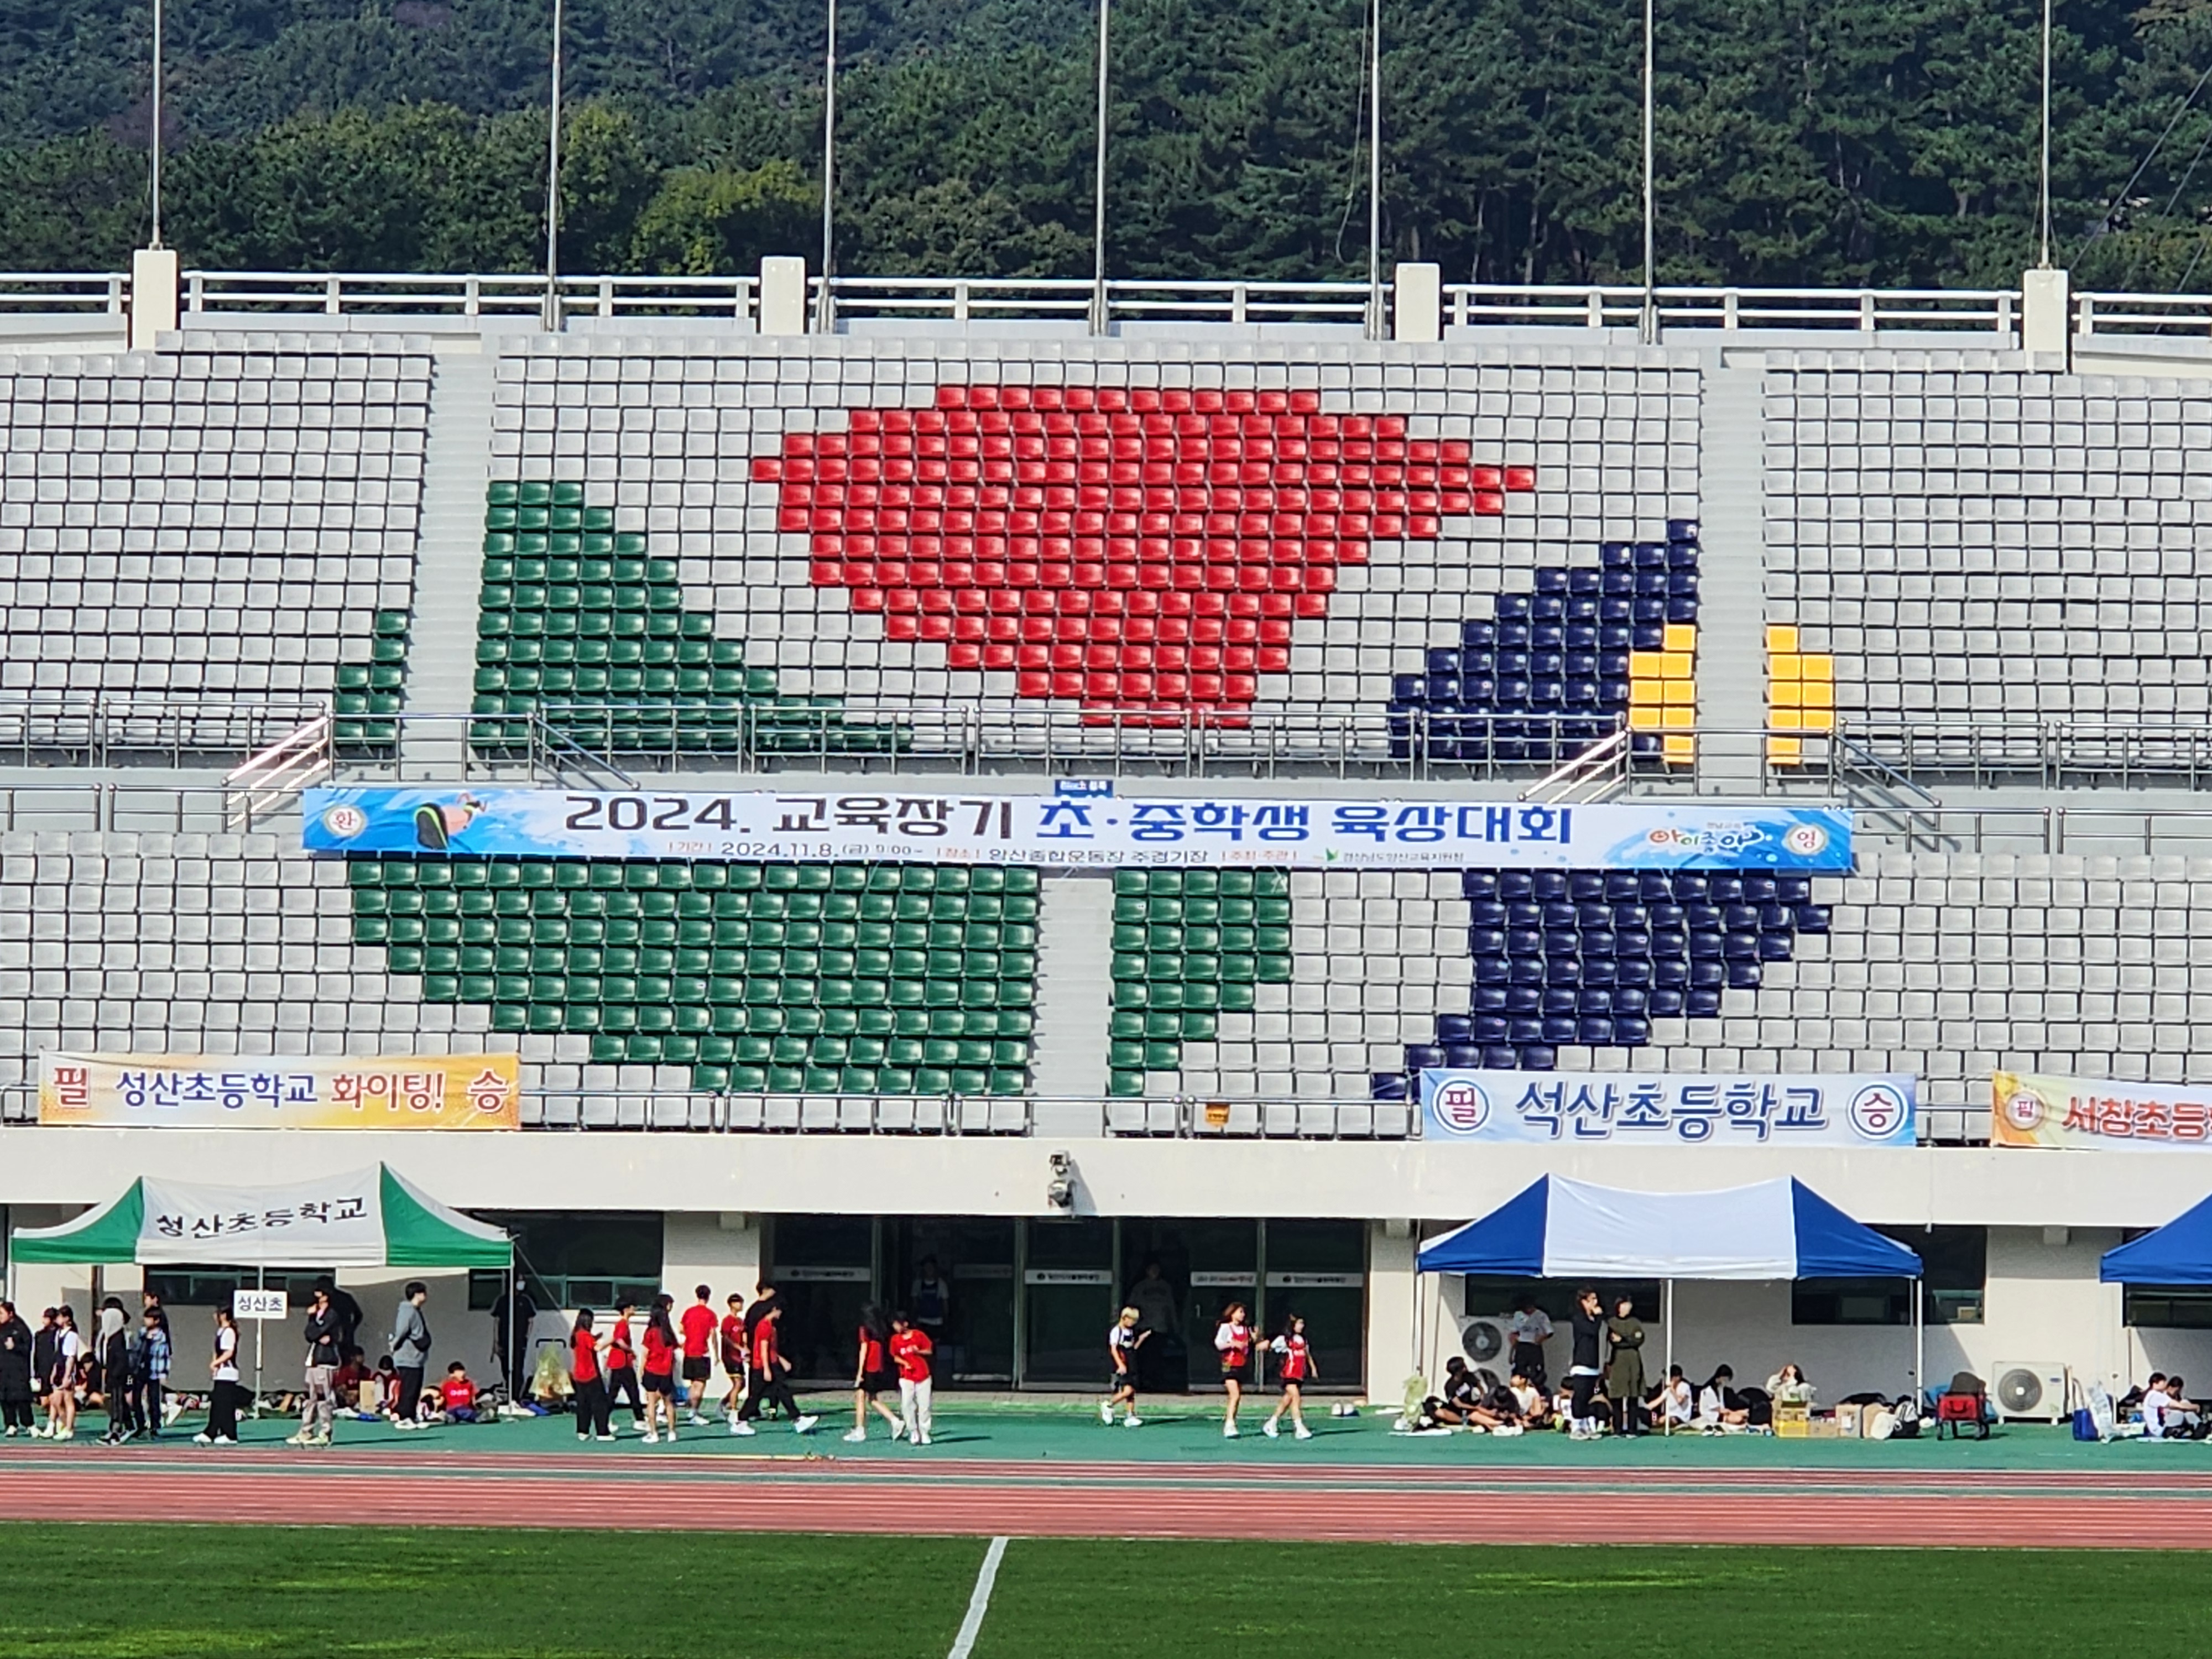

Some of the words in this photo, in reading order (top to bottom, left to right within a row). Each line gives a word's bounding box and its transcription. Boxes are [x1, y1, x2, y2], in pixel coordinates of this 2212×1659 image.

[566, 796, 750, 833] 2024.
[773, 797, 1012, 839] 교육장기
[1036, 800, 1309, 841] 초·중학생
[1331, 805, 1572, 844] 육상대회
[1797, 831, 1816, 848] 영
[1130, 849, 1208, 864] 주경기장
[54, 1067, 88, 1107] 필
[116, 1072, 319, 1109] 성산초등학교
[332, 1073, 444, 1111] 화이팅!
[468, 1069, 509, 1113] 승
[1444, 1088, 1478, 1124] 필
[1516, 1081, 1827, 1140] 석산초등학교
[1860, 1093, 1894, 1128] 승
[2017, 1101, 2033, 1118] 필
[2062, 1096, 2212, 1139] 서창초등
[156, 1197, 368, 1239] 성산초등학교
[238, 1296, 283, 1312] 성산초
